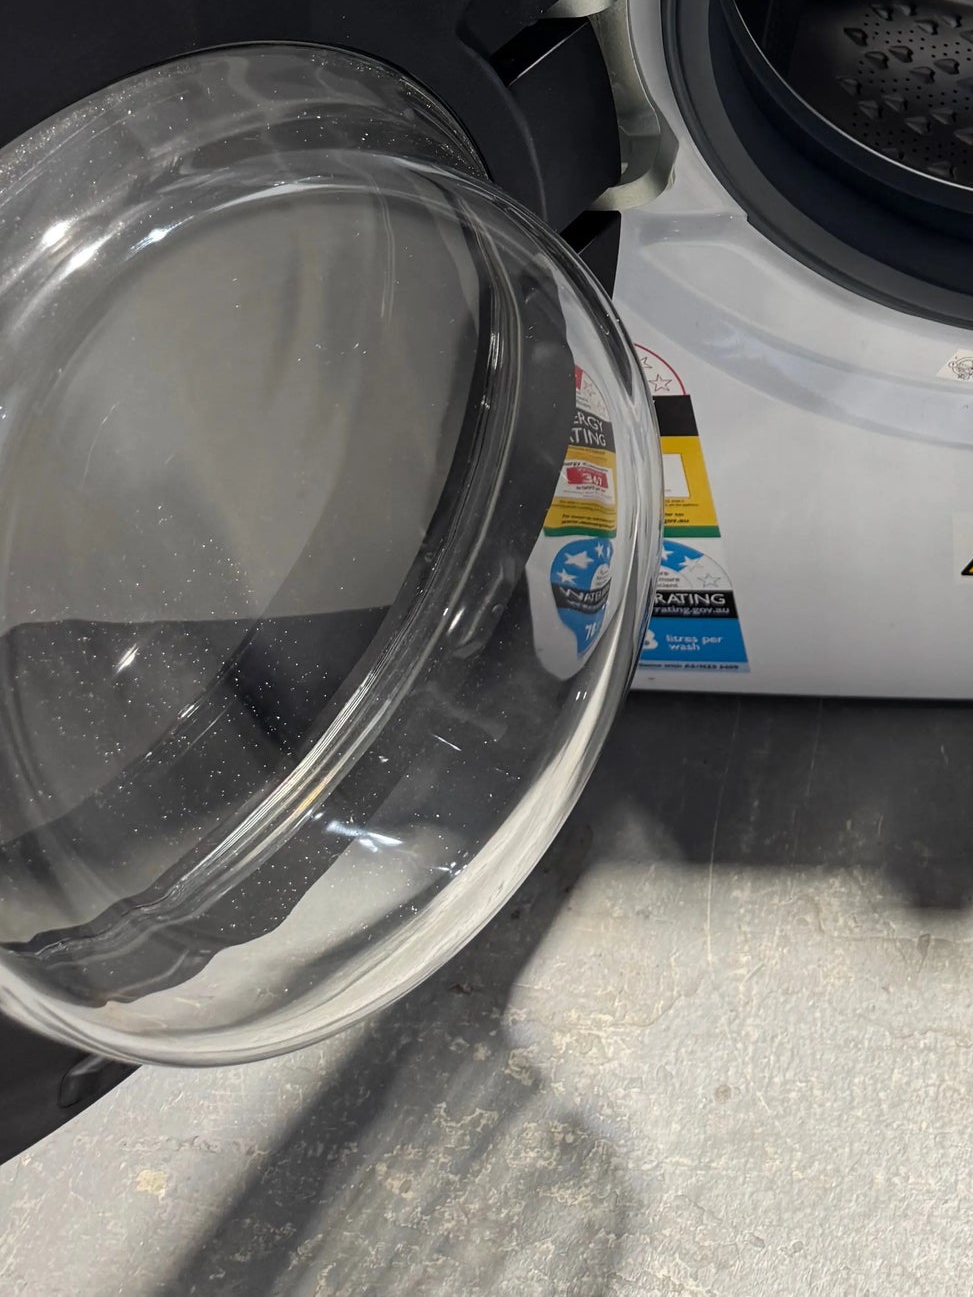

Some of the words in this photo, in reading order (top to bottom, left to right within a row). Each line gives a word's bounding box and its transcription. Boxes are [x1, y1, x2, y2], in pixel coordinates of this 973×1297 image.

[655, 593, 726, 605] RATING
[666, 634, 698, 643] litres
[702, 636, 724, 644] per
[669, 643, 700, 651] wash
